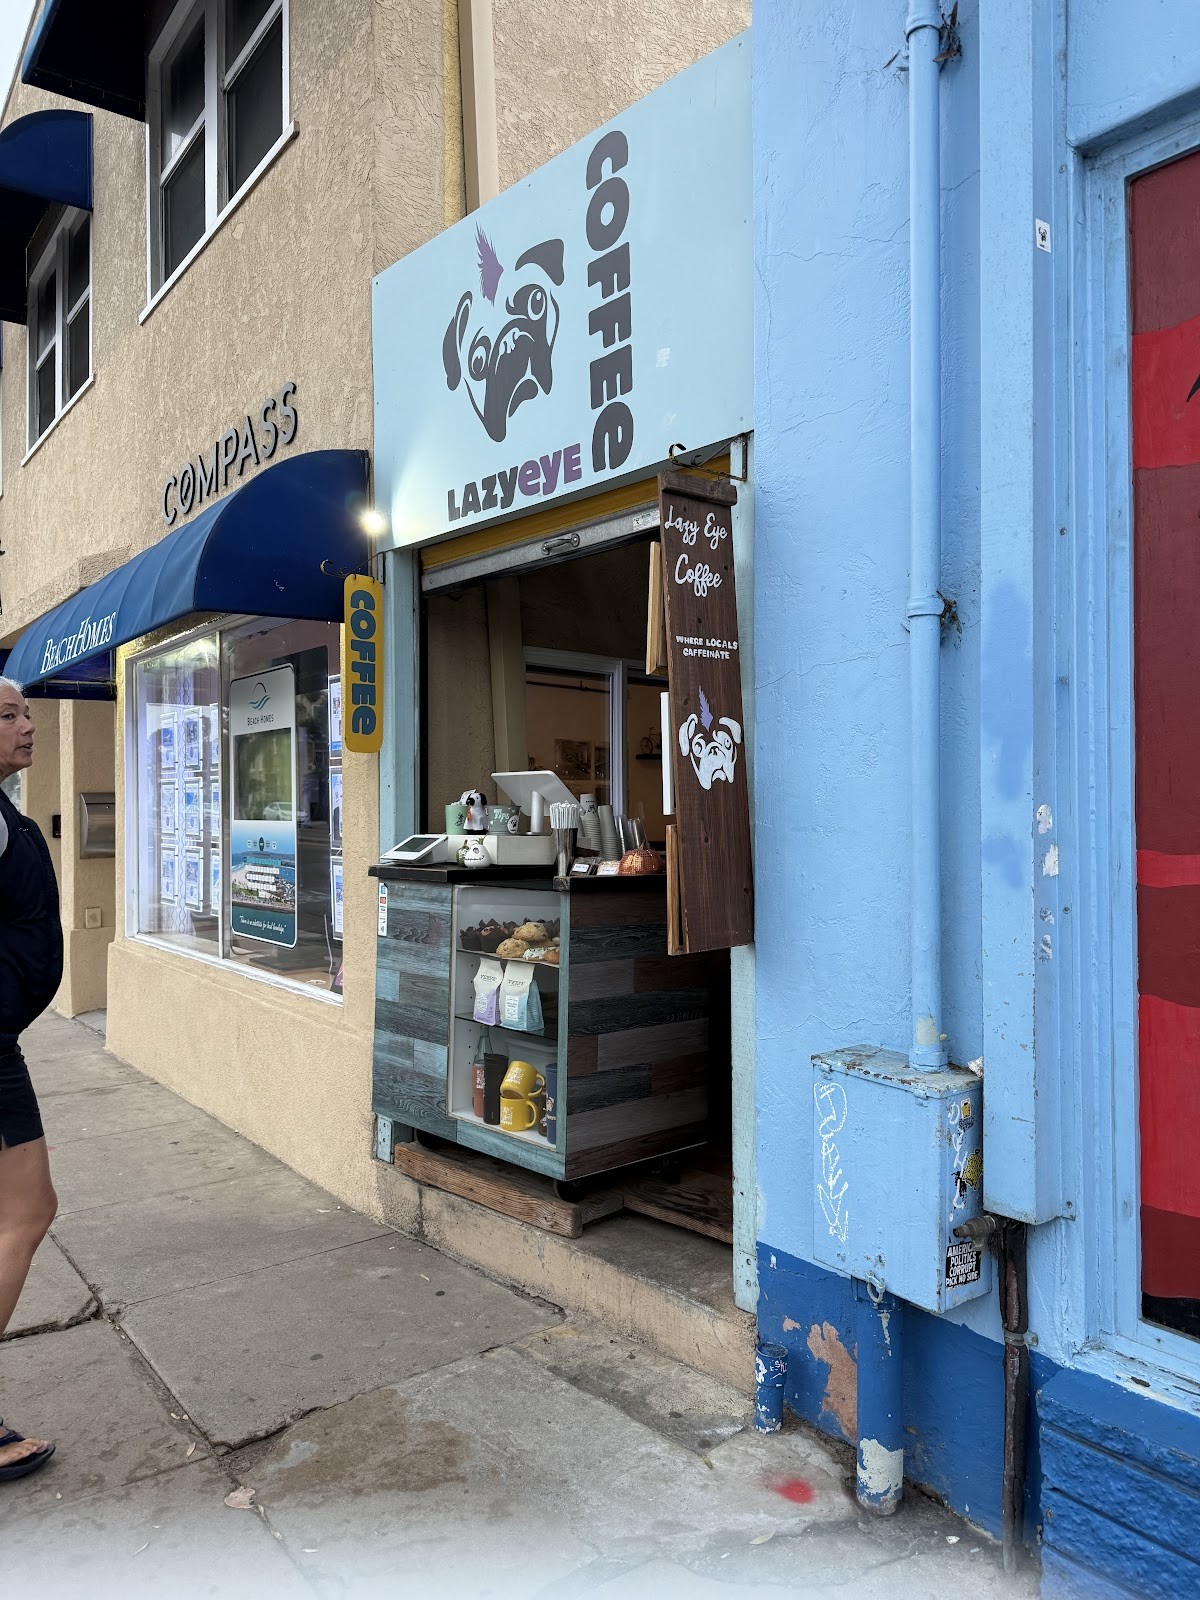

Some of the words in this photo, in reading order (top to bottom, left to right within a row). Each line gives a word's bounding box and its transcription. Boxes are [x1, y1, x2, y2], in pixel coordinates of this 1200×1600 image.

[163, 381, 298, 525] COMPASS
[665, 505, 700, 546] Lazy
[704, 512, 727, 550] Eye
[675, 553, 722, 597] Coffee
[676, 635, 703, 646] WHERE
[706, 637, 738, 650] LOCALS
[682, 647, 730, 659] CAFFEINATE
[950, 1251, 977, 1267] POLITICS
[949, 1261, 977, 1277] CORRUPT
